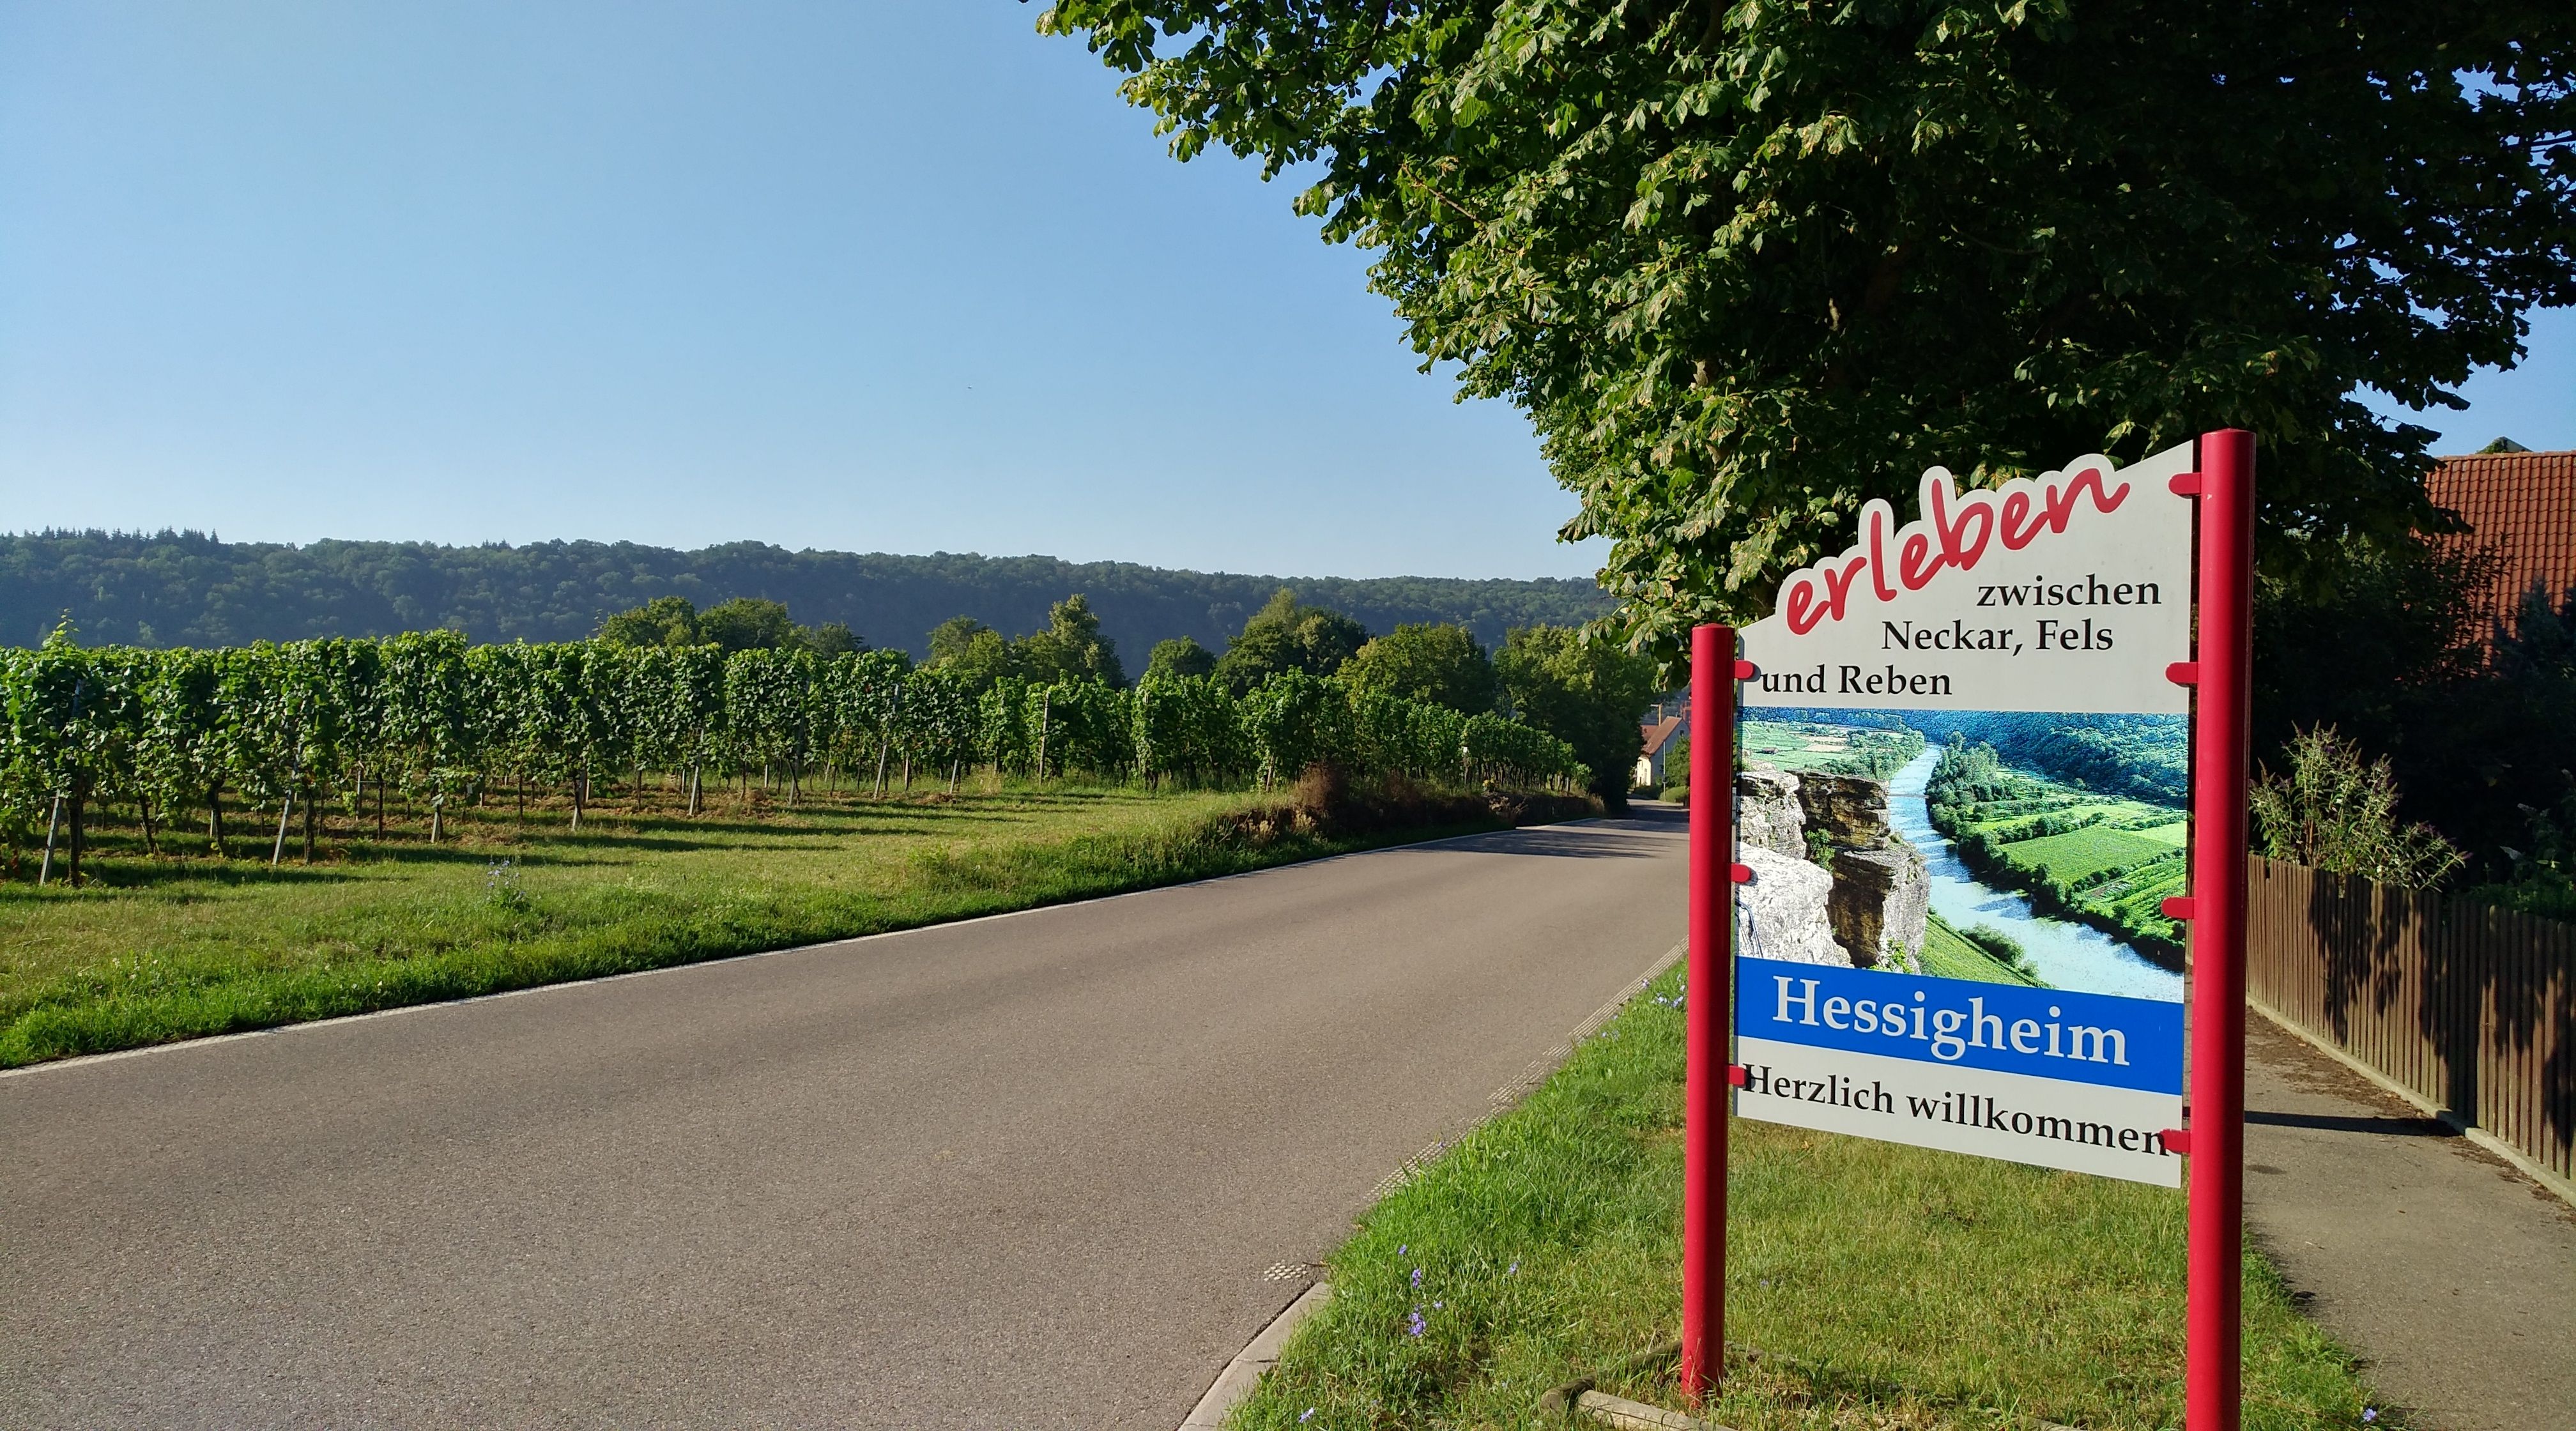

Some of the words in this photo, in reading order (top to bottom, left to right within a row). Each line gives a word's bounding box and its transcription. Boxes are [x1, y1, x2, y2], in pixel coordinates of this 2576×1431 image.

[1788, 468, 2131, 636] erleben
[1976, 574, 2162, 607] zwischen
[1880, 618, 2023, 656] Neckar,
[2035, 618, 2113, 652] Fels
[1761, 665, 1827, 695] und
[1838, 664, 1952, 696] Reben
[1772, 975, 2131, 1066] Hessigheim
[1742, 1062, 1894, 1115] Herzlich
[1906, 1091, 2170, 1157] willkommen
